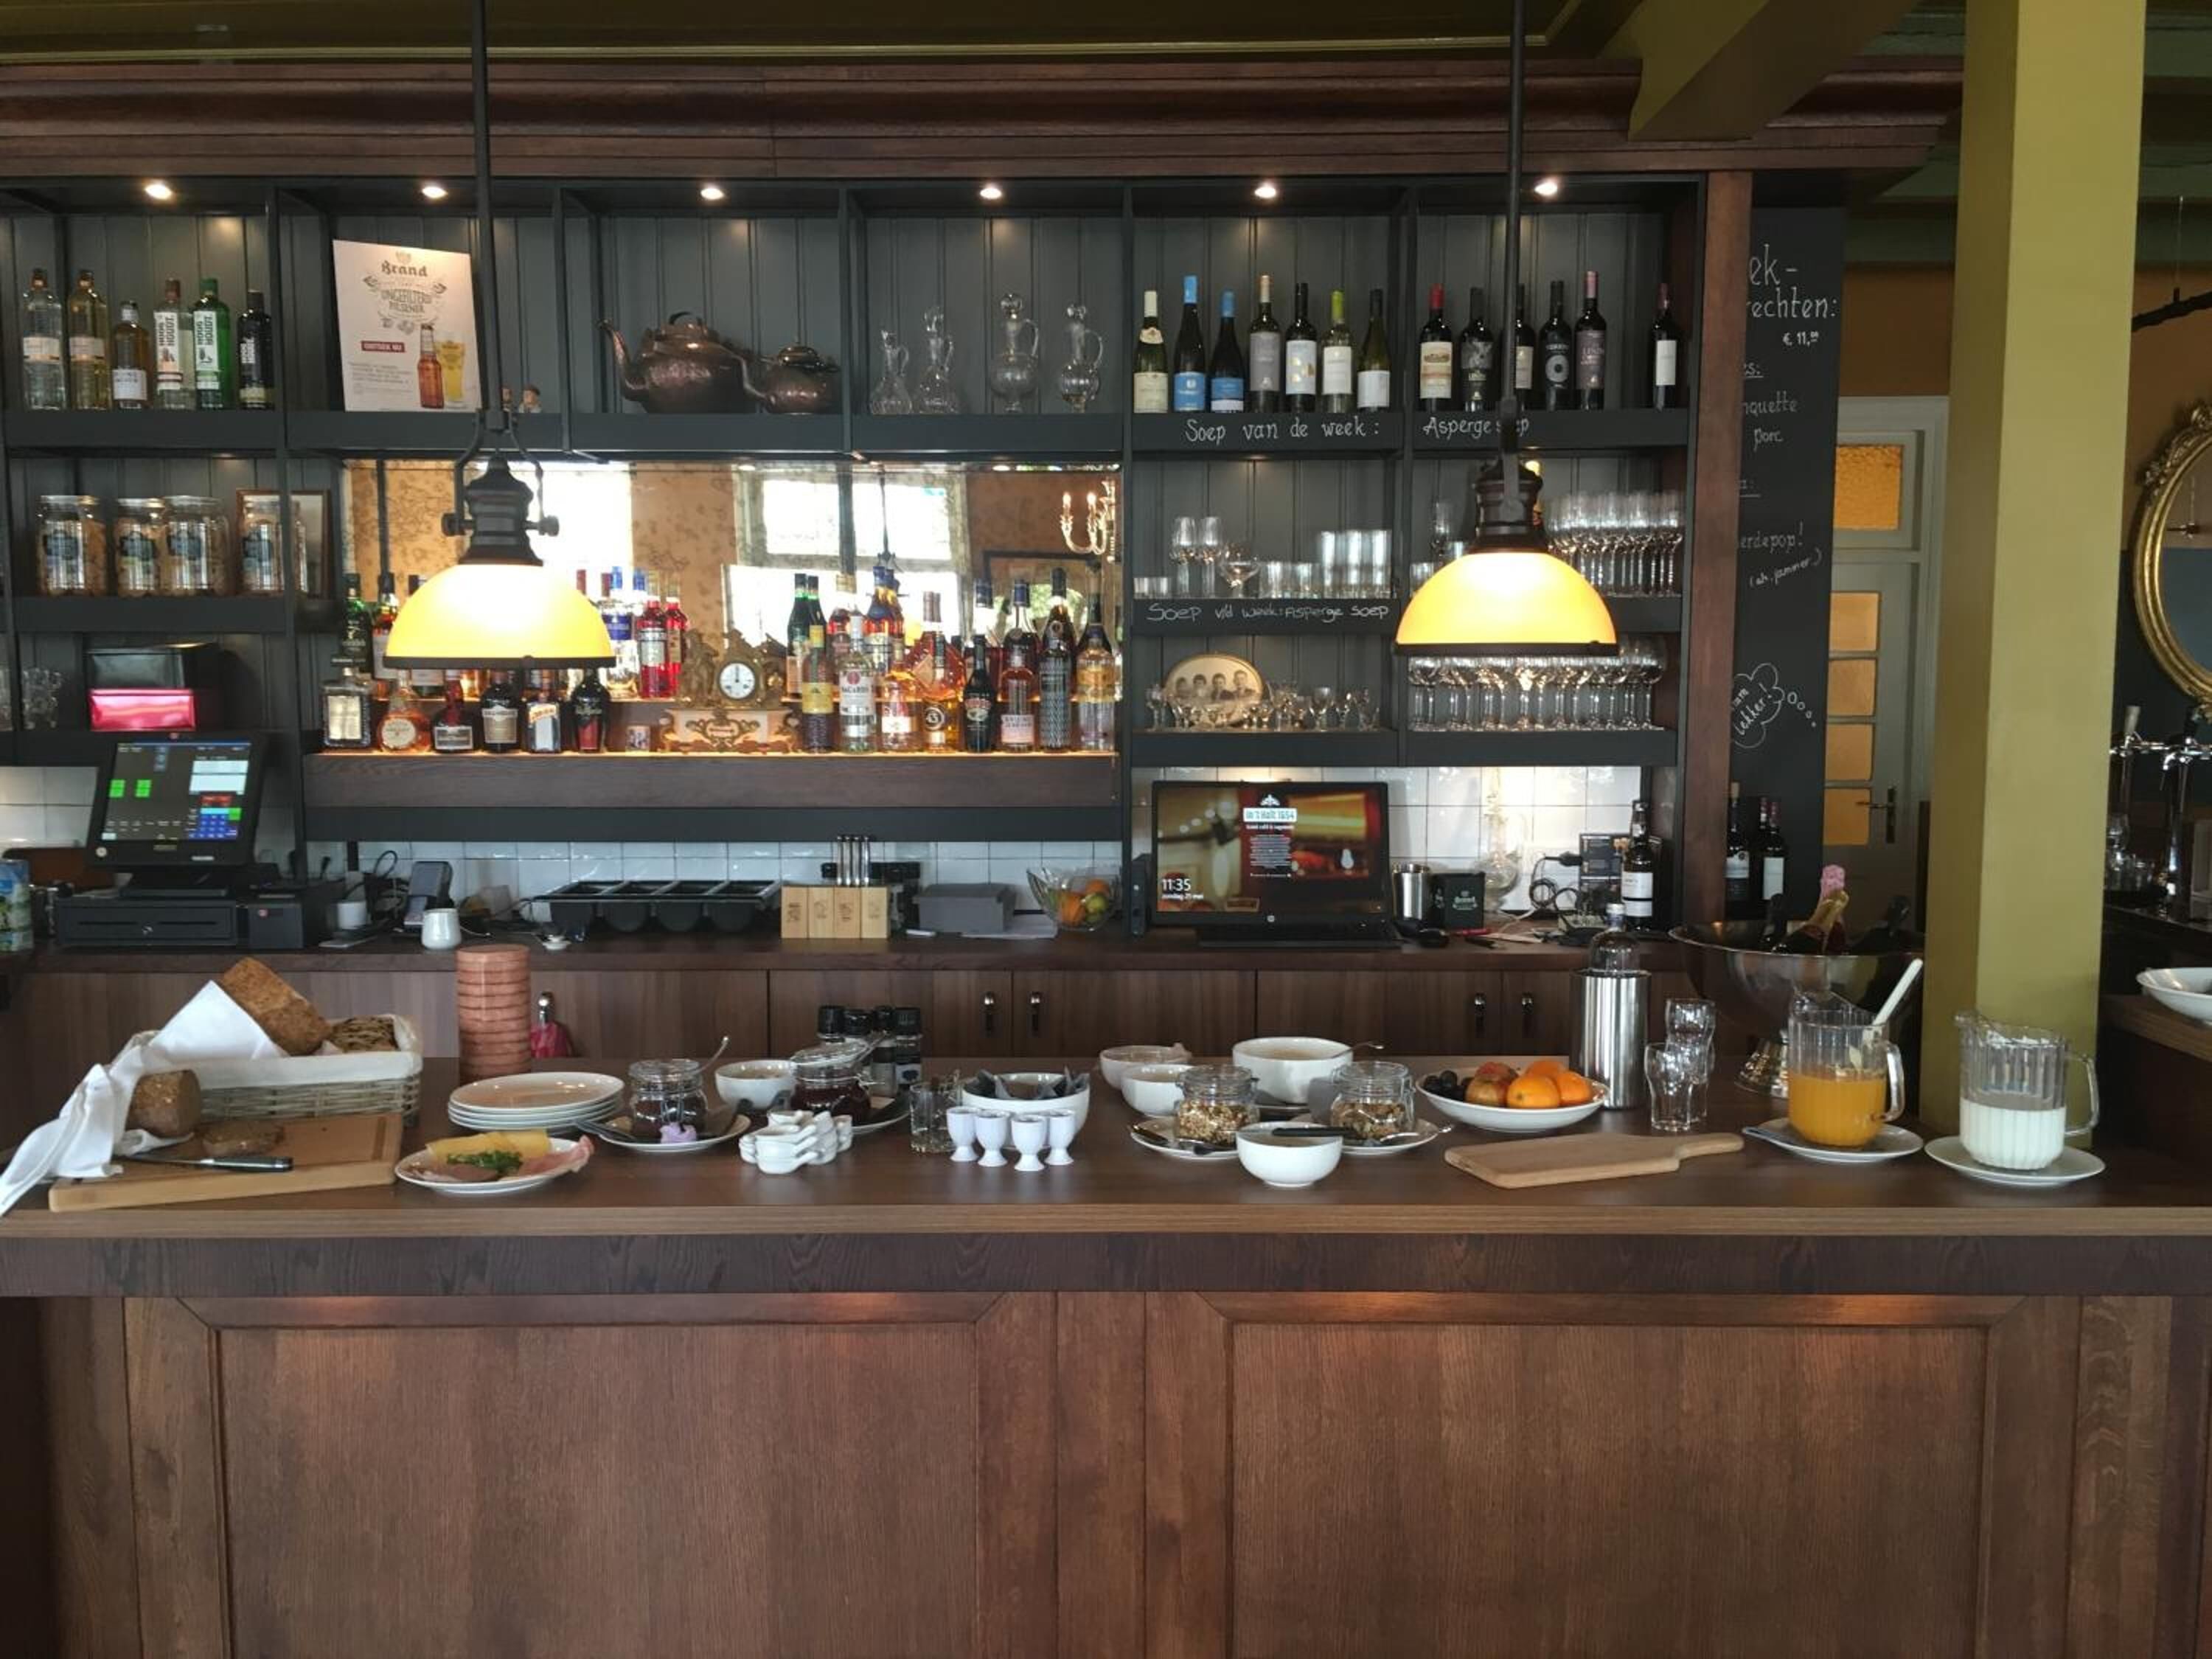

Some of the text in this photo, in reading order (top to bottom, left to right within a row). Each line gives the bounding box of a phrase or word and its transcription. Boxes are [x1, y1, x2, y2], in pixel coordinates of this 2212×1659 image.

[381, 260, 428, 277] Brand
[1746, 286, 1838, 319] echten:
[1186, 418, 1227, 445] Soep
[1242, 422, 1279, 440] van
[1290, 417, 1309, 437] de
[1422, 416, 1530, 440] Asperge sp
[1147, 602, 1203, 622] Soep
[1350, 605, 1388, 619] soep
[1161, 877, 1192, 891] 11:35
